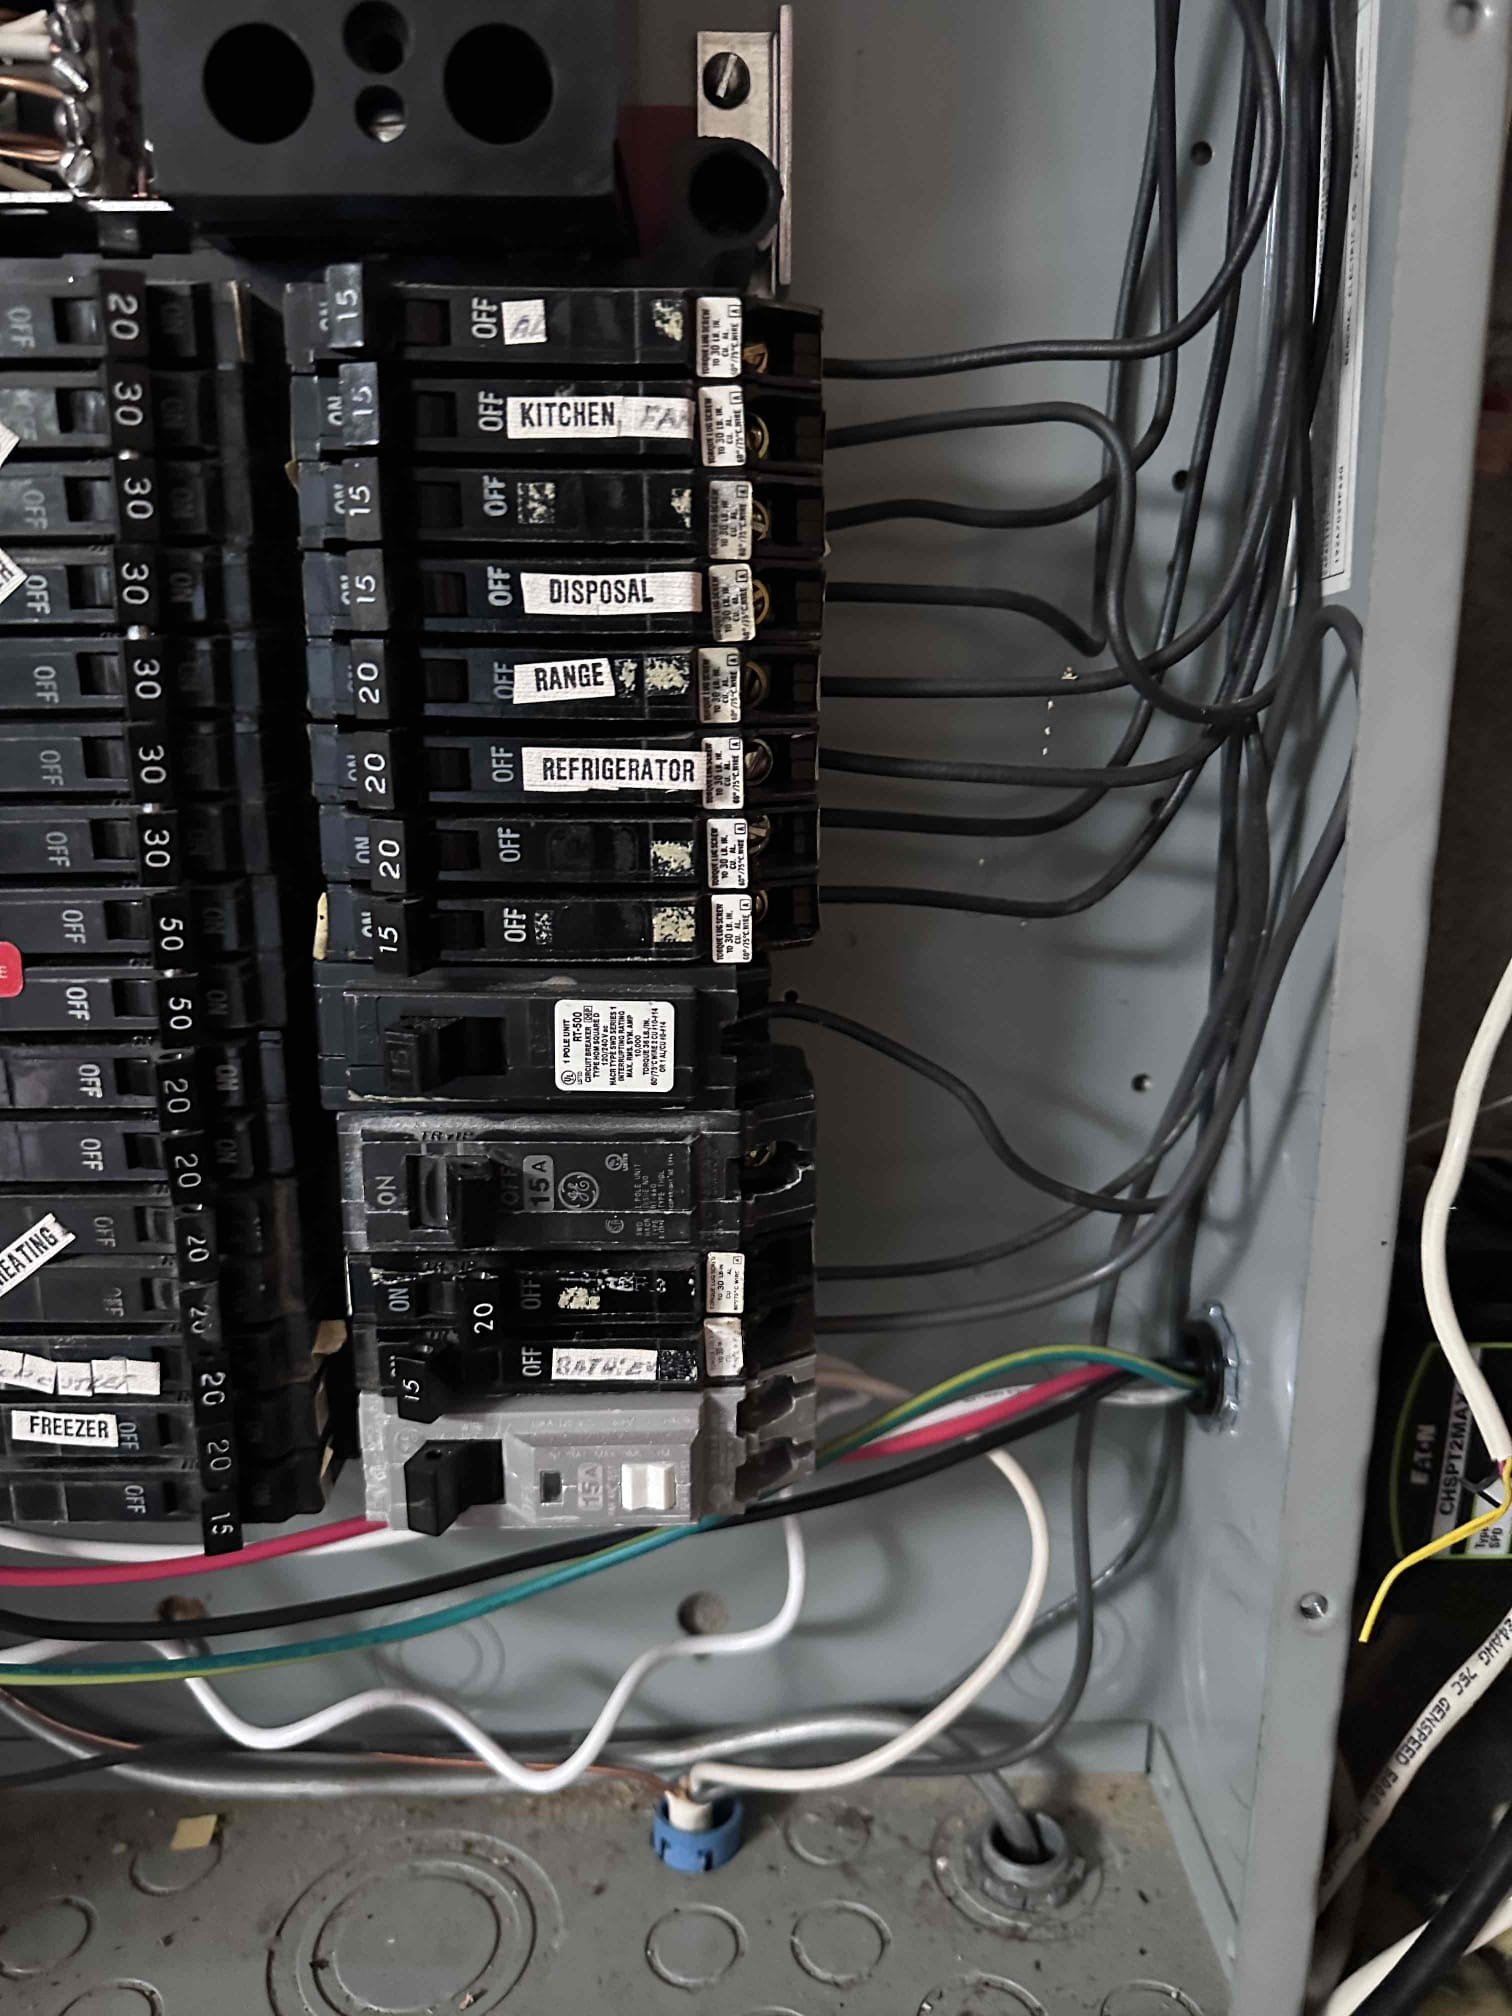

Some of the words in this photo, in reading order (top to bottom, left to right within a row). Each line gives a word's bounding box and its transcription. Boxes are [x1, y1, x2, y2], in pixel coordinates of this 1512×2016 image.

[108, 294, 139, 341] 20
[335, 288, 359, 322] 15
[472, 297, 499, 339] OFF
[8, 306, 35, 349] OFF
[114, 380, 143, 426] 30
[352, 383, 374, 417] 15
[478, 390, 504, 432] OFF
[520, 401, 615, 428] KITCHEN
[22, 489, 48, 529] OFF
[124, 476, 153, 520] 30
[349, 484, 371, 517] 15
[482, 475, 508, 517] OFF
[26, 574, 51, 614] OFF
[121, 561, 149, 605] 30
[355, 574, 377, 606] 15
[487, 566, 513, 607] OFF
[549, 578, 655, 605] DISPOSAL
[33, 665, 59, 704] OFF
[133, 657, 162, 700] 30
[358, 661, 380, 705] 20
[494, 661, 514, 700] OFF
[534, 661, 605, 692] RANGE
[40, 749, 64, 786] OFF
[139, 744, 167, 785] 30
[364, 752, 386, 795] 20
[492, 745, 515, 783] OFF
[542, 756, 696, 783] REFRIGERATOR
[46, 831, 70, 868] OFF
[144, 828, 171, 869] 30
[379, 838, 402, 880] 20
[498, 826, 521, 863] OFF
[719, 858, 729, 869] 30
[62, 909, 86, 945] OFF
[504, 907, 527, 943] OFF
[716, 903, 724, 923] SCREW
[160, 916, 184, 951] 50
[378, 926, 399, 953] 15
[716, 938, 725, 960] TORQUE
[724, 933, 734, 944] 30
[726, 945, 734, 954] TO
[65, 986, 90, 1021] OFF
[168, 996, 192, 1030] 50
[562, 1019, 570, 1037] UNIT
[572, 1012, 582, 1042] RT-500
[609, 1012, 617, 1034] SERIES
[617, 1011, 625, 1034] RATING
[651, 1031, 658, 1040] CU
[562, 1038, 571, 1058] POLE
[584, 1026, 592, 1057] BREAKER
[601, 1039, 609, 1066] 120/240
[609, 1035, 617, 1050] SWD
[634, 1035, 643, 1057] 10,000
[642, 1040, 650, 1049] 36
[584, 1057, 592, 1083] CIRCUIT
[592, 1062, 600, 1078] TYPE
[609, 1051, 617, 1067] TYPE
[617, 1035, 625, 1082] INTERRUPTING
[642, 1050, 650, 1076] TORQUE
[659, 1063, 667, 1073] OR
[79, 1064, 103, 1099] OFF
[163, 1077, 190, 1114] 20
[80, 1138, 103, 1172] OFF
[175, 1152, 202, 1189] 20
[375, 1174, 398, 1207] ON
[94, 1216, 116, 1248] OFF
[186, 1235, 210, 1263] 20
[388, 1286, 410, 1313] ON
[521, 1278, 542, 1310] OFF
[190, 1305, 214, 1334] 20
[473, 1302, 495, 1335] 20
[521, 1345, 543, 1378] OFF
[201, 1371, 226, 1406] 20
[403, 1378, 421, 1402] 15
[29, 1414, 110, 1439] FREEZER
[118, 1421, 139, 1451] OFF
[208, 1438, 232, 1472] 20
[124, 1485, 146, 1515] OFF
[210, 1511, 234, 1536] 15
[1450, 1666, 1478, 1697] 75C
[1394, 1696, 1451, 1768] GENSPEED
